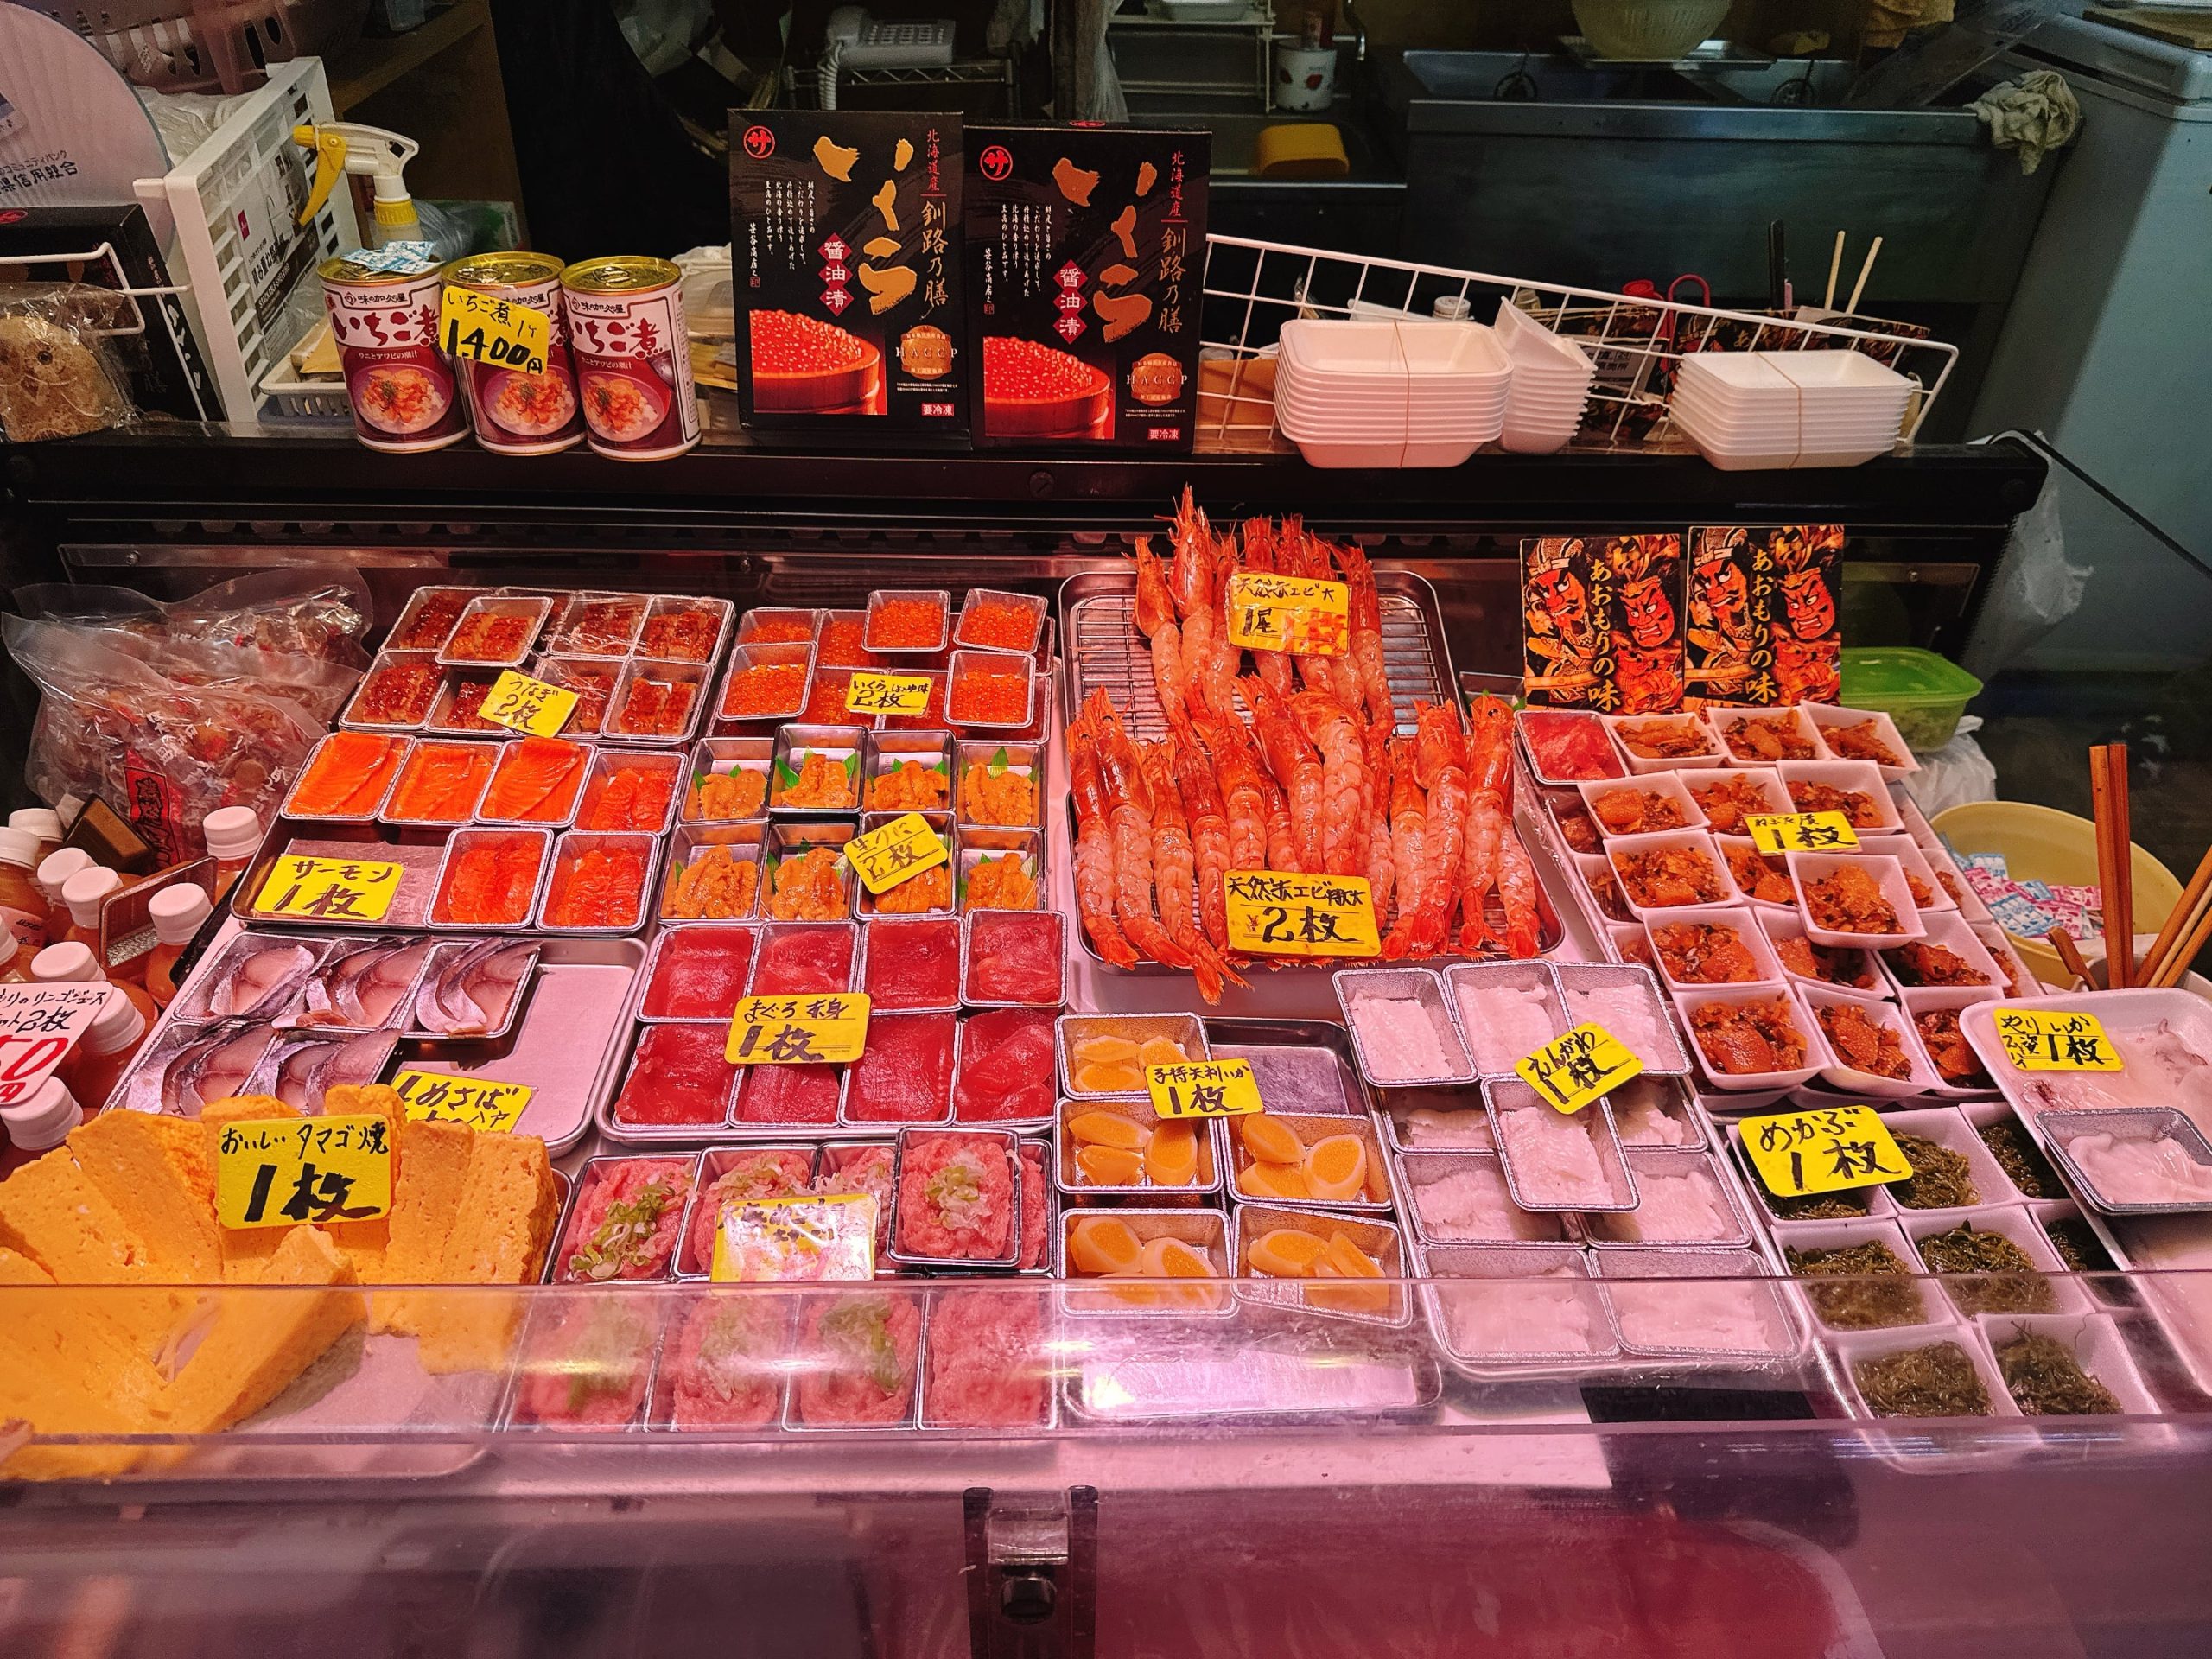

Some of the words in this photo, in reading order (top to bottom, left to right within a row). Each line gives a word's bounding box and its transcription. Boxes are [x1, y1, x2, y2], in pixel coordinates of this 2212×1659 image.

[926, 129, 940, 191] 北海道産
[1170, 150, 1185, 217] 北海道産
[919, 200, 949, 320] 釧路乃膳
[1158, 227, 1186, 334] 釧路乃膳
[332, 303, 440, 346] いちご煮
[448, 292, 512, 327] いちご煮
[895, 346, 958, 358] HACCP
[1126, 374, 1188, 385] HACCP
[923, 404, 953, 415] 要冷凍
[1149, 429, 1179, 440] 要冷凍
[1587, 557, 1621, 712] あおもりの味
[1745, 549, 1778, 706] あおもりの味
[509, 677, 559, 702] うなぎ
[852, 690, 921, 709] 2枚
[493, 693, 542, 730] 2枚
[1770, 826, 1858, 849] 1枚
[292, 860, 393, 883] サーモン
[863, 840, 922, 880] 2枚
[273, 883, 368, 917] 1枚
[1262, 906, 1359, 944] 2枚
[743, 999, 797, 1023] まぐろ
[738, 1024, 824, 1061] 1枚
[1526, 1031, 1596, 1081] えんがわ
[2048, 1033, 2105, 1065] 1枚
[397, 1075, 520, 1111] しめさば
[1541, 1053, 1618, 1105] 1枚
[1168, 1083, 1244, 1115] 1枚
[221, 1128, 286, 1154] おいしい
[297, 1122, 389, 1160] タマゴ焼
[1760, 1108, 1862, 1153] めかぶ
[1790, 1139, 1903, 1192] 1枚
[244, 1162, 382, 1223] 1枚
